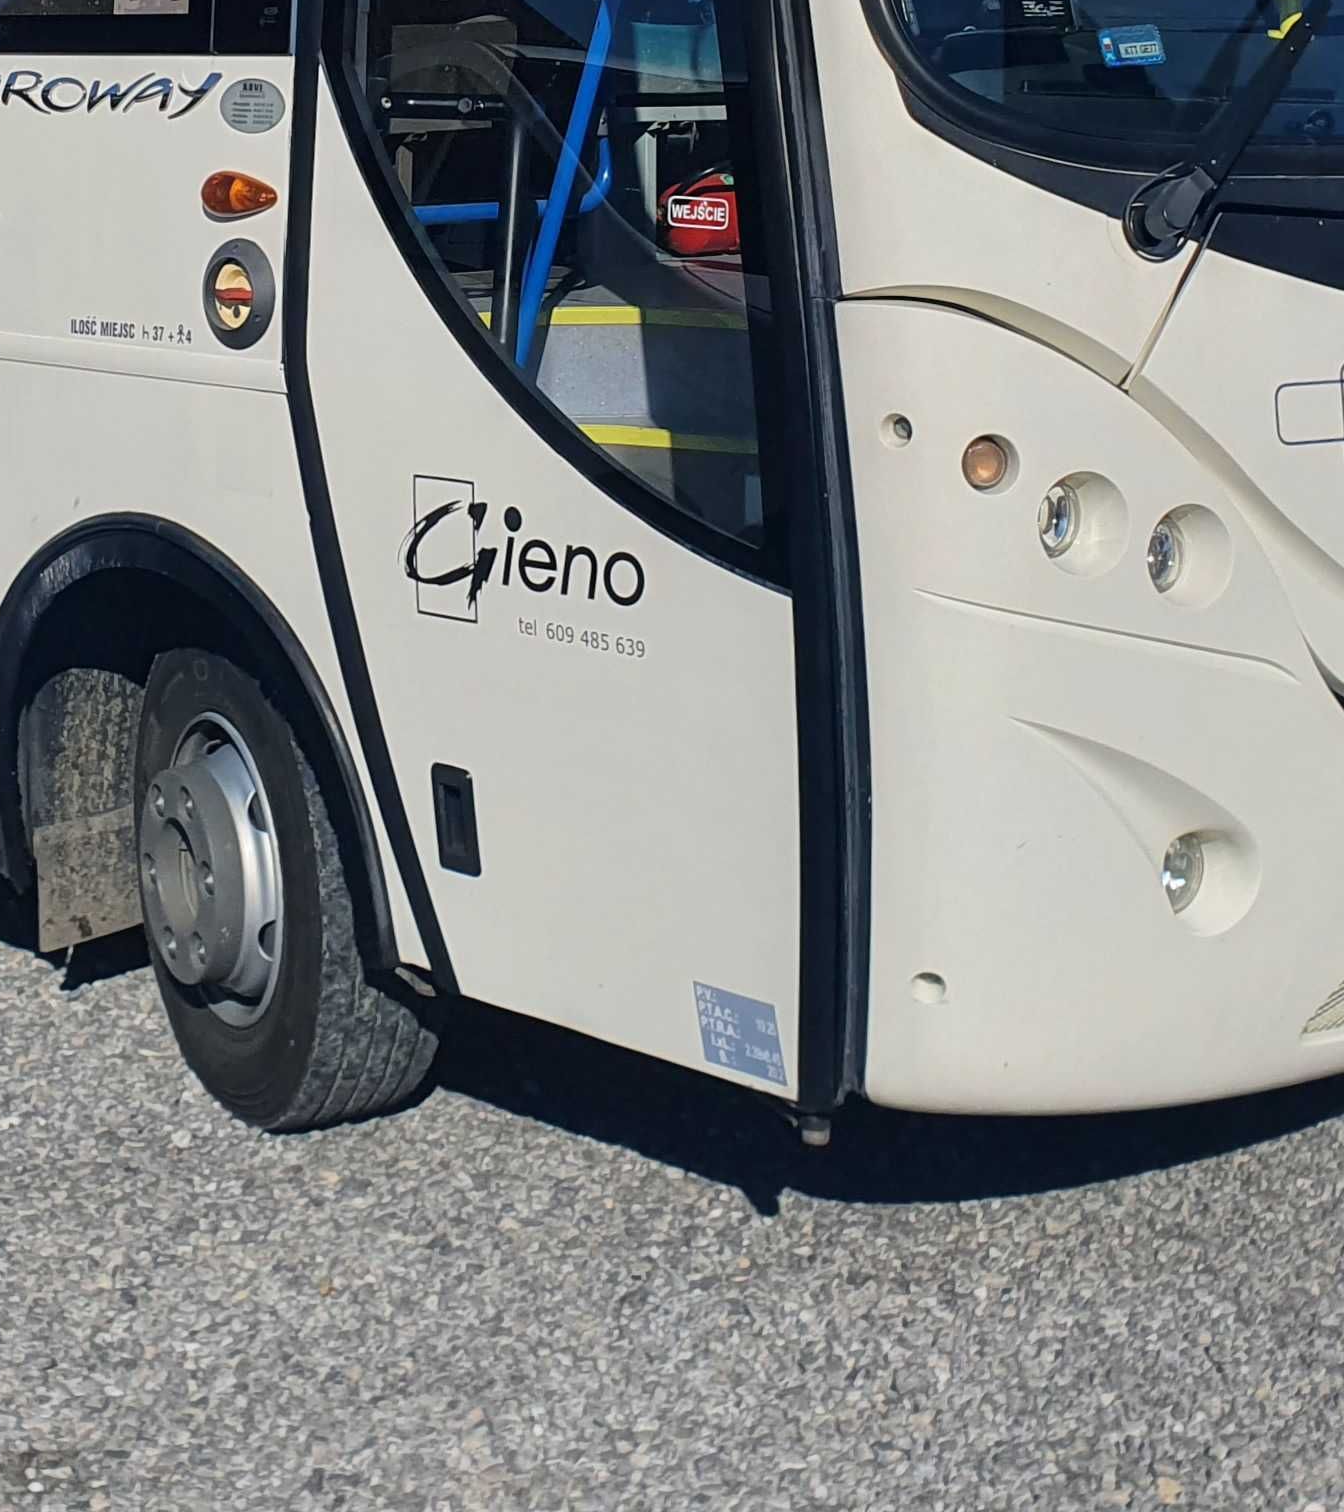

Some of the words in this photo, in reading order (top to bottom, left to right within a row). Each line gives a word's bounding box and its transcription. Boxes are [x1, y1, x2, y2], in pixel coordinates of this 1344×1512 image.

[671, 201, 726, 222] WEJŚCIE
[70, 315, 97, 336] ILOŚĆ
[100, 320, 136, 339] MIEJSC
[152, 326, 165, 342] 37
[398, 500, 646, 609] Gieno
[518, 617, 537, 636] tel
[545, 622, 574, 644] 609
[580, 629, 610, 651] 485
[615, 636, 646, 658] 639
